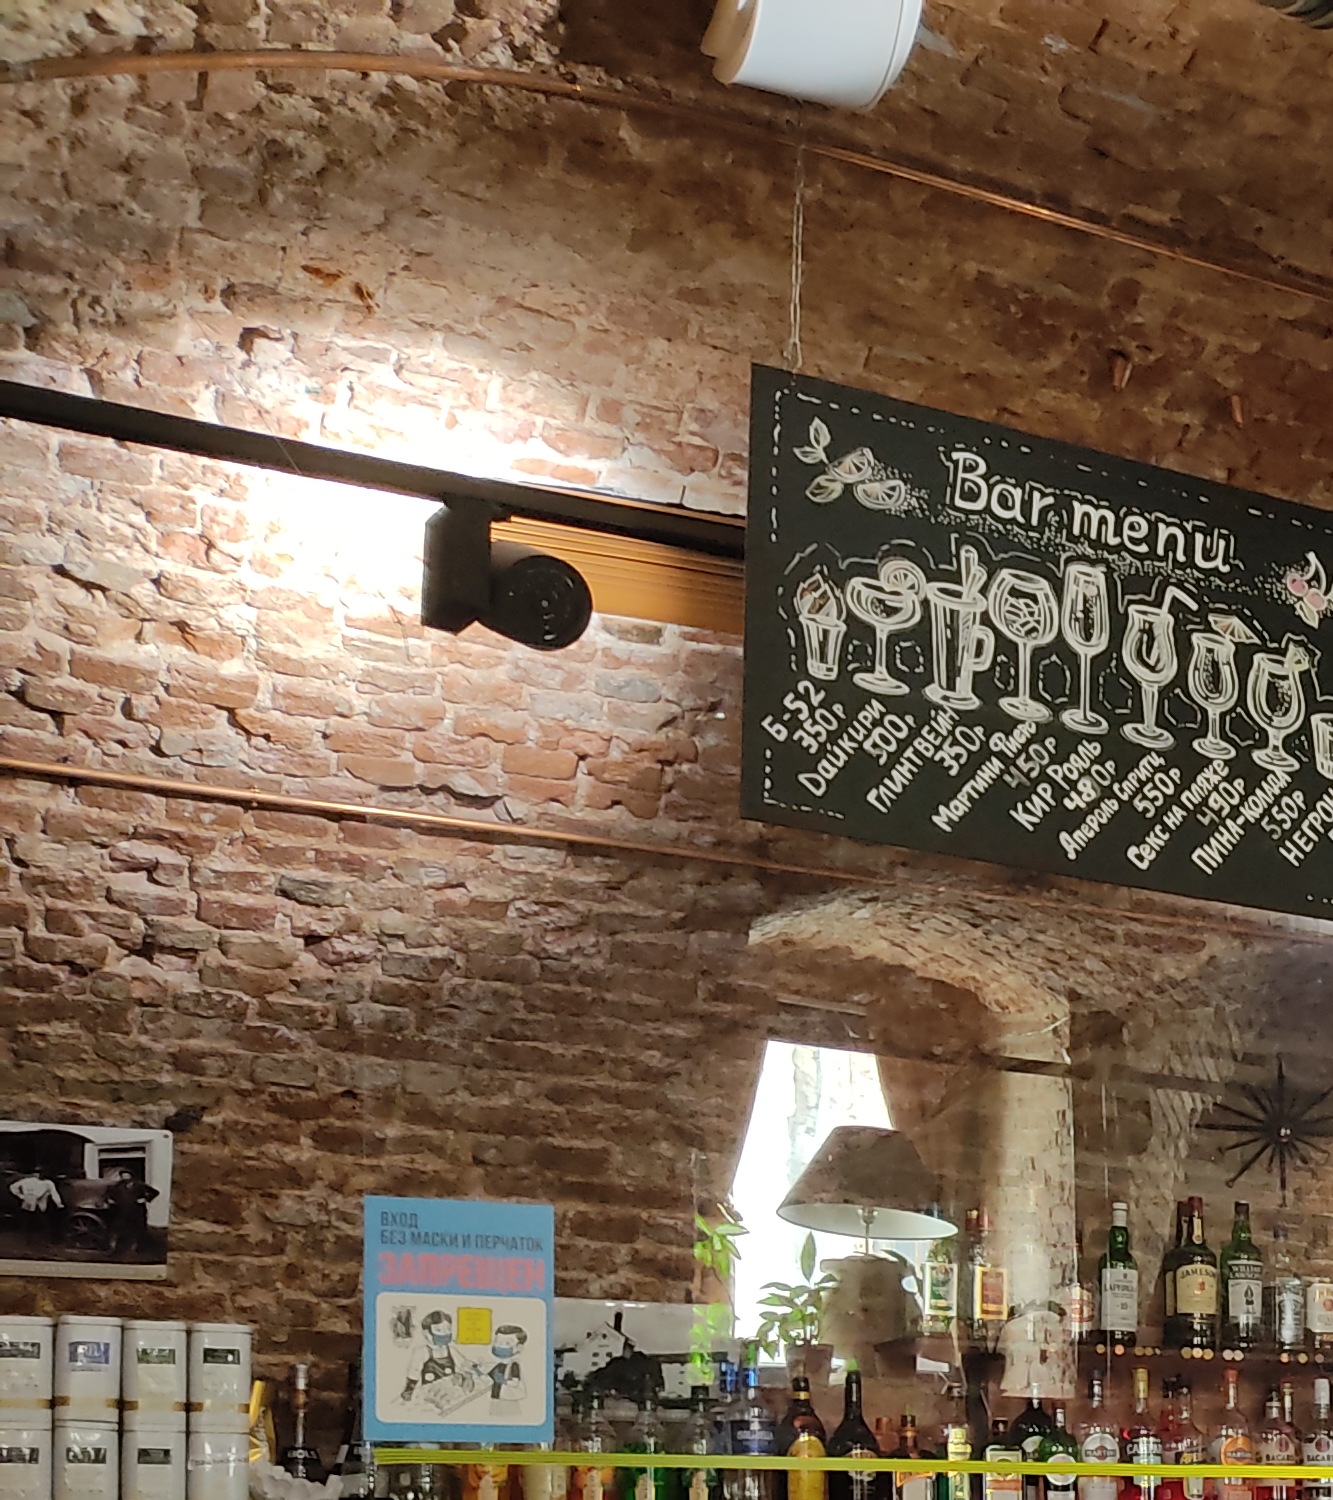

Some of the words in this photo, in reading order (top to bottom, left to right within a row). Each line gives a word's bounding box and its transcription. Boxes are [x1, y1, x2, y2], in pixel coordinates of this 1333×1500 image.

[951, 451, 1055, 527] Bar
[1071, 500, 1231, 574] menu
[761, 680, 826, 743] Б-52
[380, 1210, 419, 1230] ВХОД
[380, 1229, 406, 1246] БЕЗ
[410, 1230, 459, 1248] МАСКИ
[461, 1233, 471, 1249] И
[475, 1233, 544, 1252] ПЕРЧАТОК
[378, 1251, 545, 1293] ЗАПРЕЩЕН
[1265, 1453, 1294, 1462] BACARD
